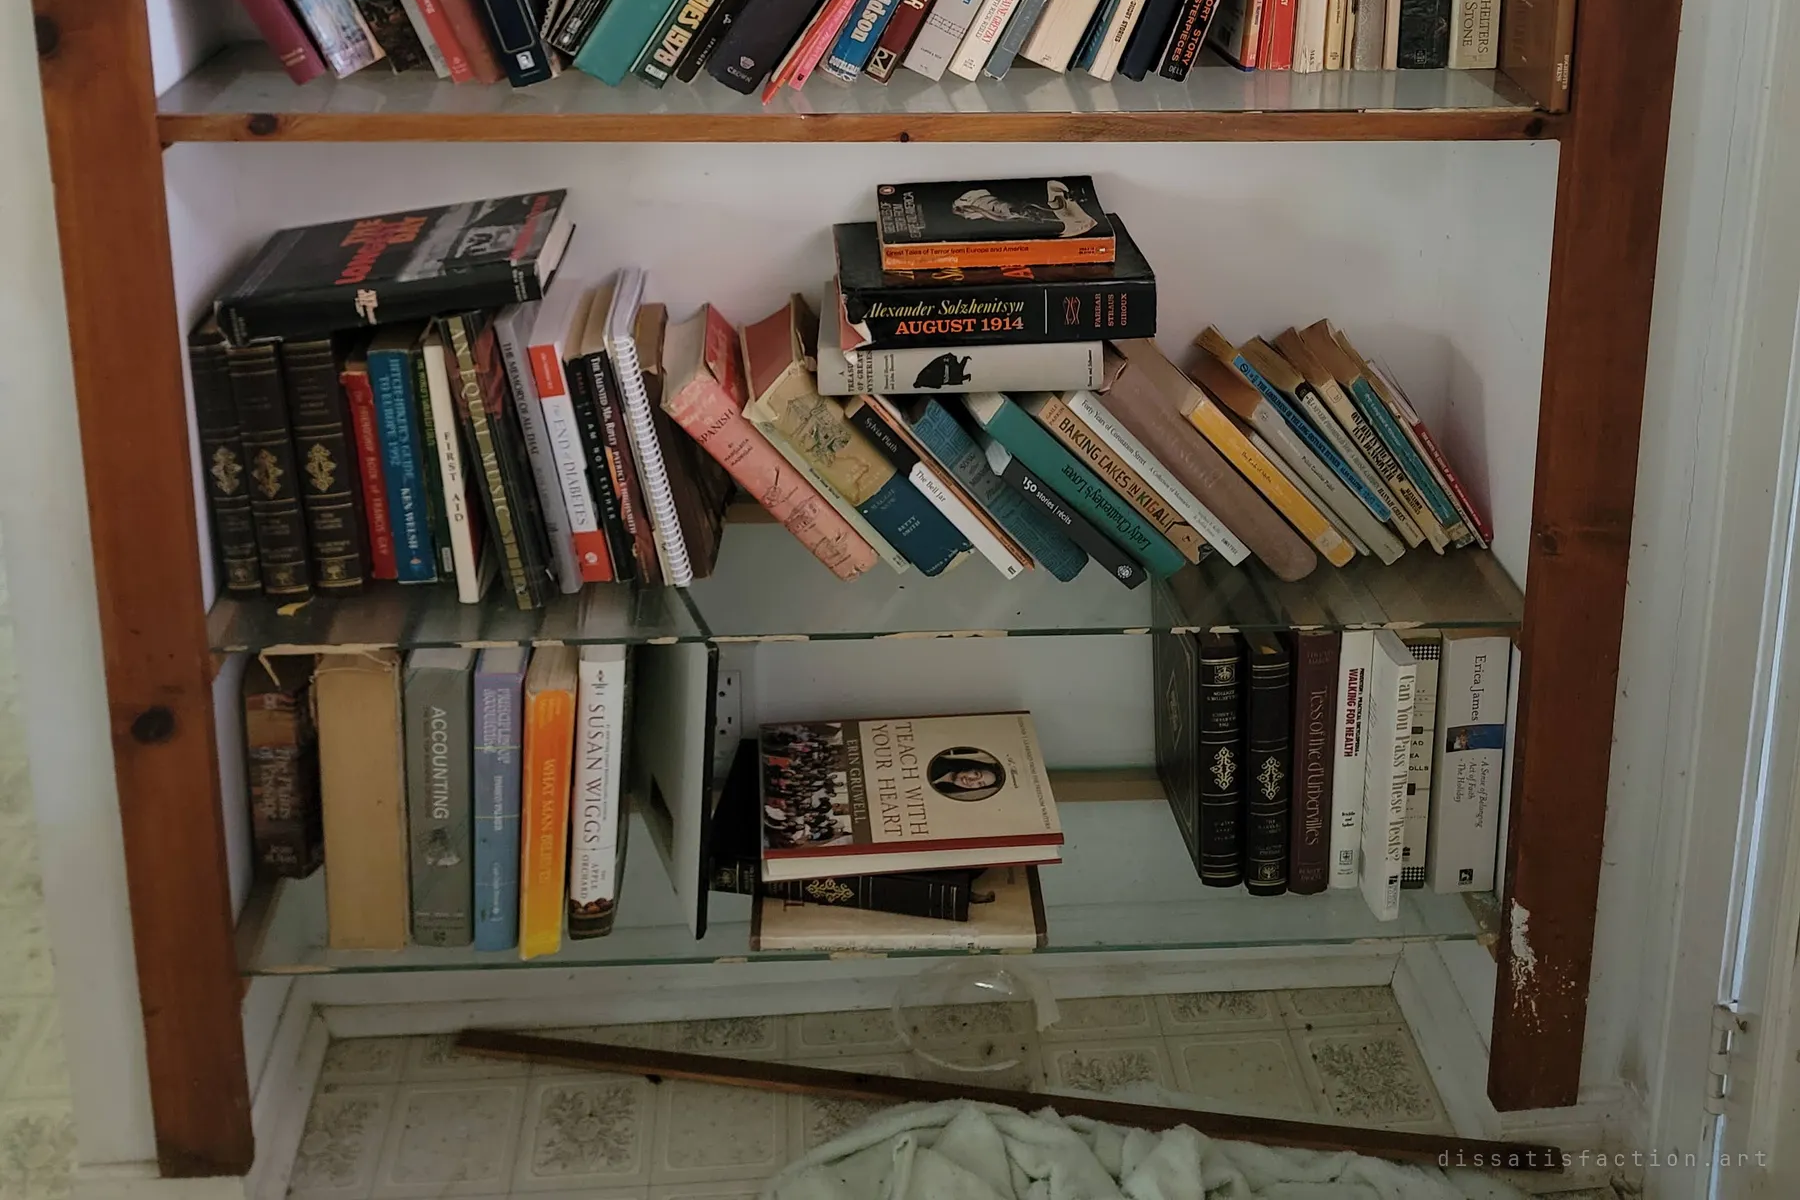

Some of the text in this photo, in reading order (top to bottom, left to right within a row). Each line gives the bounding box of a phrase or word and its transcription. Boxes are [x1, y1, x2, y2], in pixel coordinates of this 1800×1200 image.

[651, 22, 693, 69] 1978
[1461, 1, 1477, 46] STONE
[1179, 28, 1202, 65] STORY
[725, 64, 752, 84] CROWN
[1168, 64, 1183, 76] DELL
[861, 296, 1024, 319] Alexander Solzhenitsyn
[895, 316, 1023, 336] AUGUST 1914
[1107, 293, 1115, 326] STRAUS
[1119, 293, 1127, 325] GIROUX
[857, 382, 863, 390] OF
[865, 351, 873, 392] MYSTERIES
[503, 342, 538, 456] THE MEMORY OF ALL THAT
[448, 325, 510, 521] AN EQUAL MUSIC
[692, 407, 737, 446] SPANISH
[863, 416, 884, 437] Sylvia
[880, 434, 899, 452] Plath
[1080, 399, 1147, 466] Forty Years of Coronation Street
[442, 432, 463, 522] FIRST AID
[552, 418, 588, 526] END DIABETES
[587, 423, 596, 439] AM
[593, 446, 603, 469] NOT
[599, 476, 615, 520] ESTHER
[1056, 415, 1103, 463] BAKING
[1097, 453, 1133, 489] CAKES
[1126, 482, 1141, 497] IN
[915, 469, 928, 483] The
[925, 480, 939, 494] Bell
[935, 491, 947, 503] Jar
[1018, 475, 1073, 525] 150 stories récits
[1058, 463, 1154, 552] Lady Chatterley's Lover
[1376, 486, 1406, 522] HANNAH GREEN
[400, 487, 418, 549] KEN WELSH
[1309, 686, 1326, 719] Tess
[1468, 655, 1485, 721] Erica James
[1309, 722, 1325, 735] of
[1343, 668, 1358, 757] WALKING FOR HEALTH
[429, 706, 450, 819] ACCOUNTING
[1308, 739, 1325, 760] the
[1385, 674, 1414, 861] Can You Pass These Tests?
[540, 758, 556, 831] WHAT MAN
[583, 704, 604, 843] SUSAN WIGGS
[846, 739, 866, 823] ERIN GRUWELL
[868, 723, 904, 838] YOUR HEART
[892, 721, 930, 837] TEACH WITH
[1454, 777, 1464, 802] Holiday
[1467, 782, 1475, 799] Faith
[1303, 762, 1325, 845] d'Urbervilles
[1475, 795, 1486, 827] Belonging
[579, 854, 589, 899] ORCHARD
[589, 864, 599, 890] APPLE
